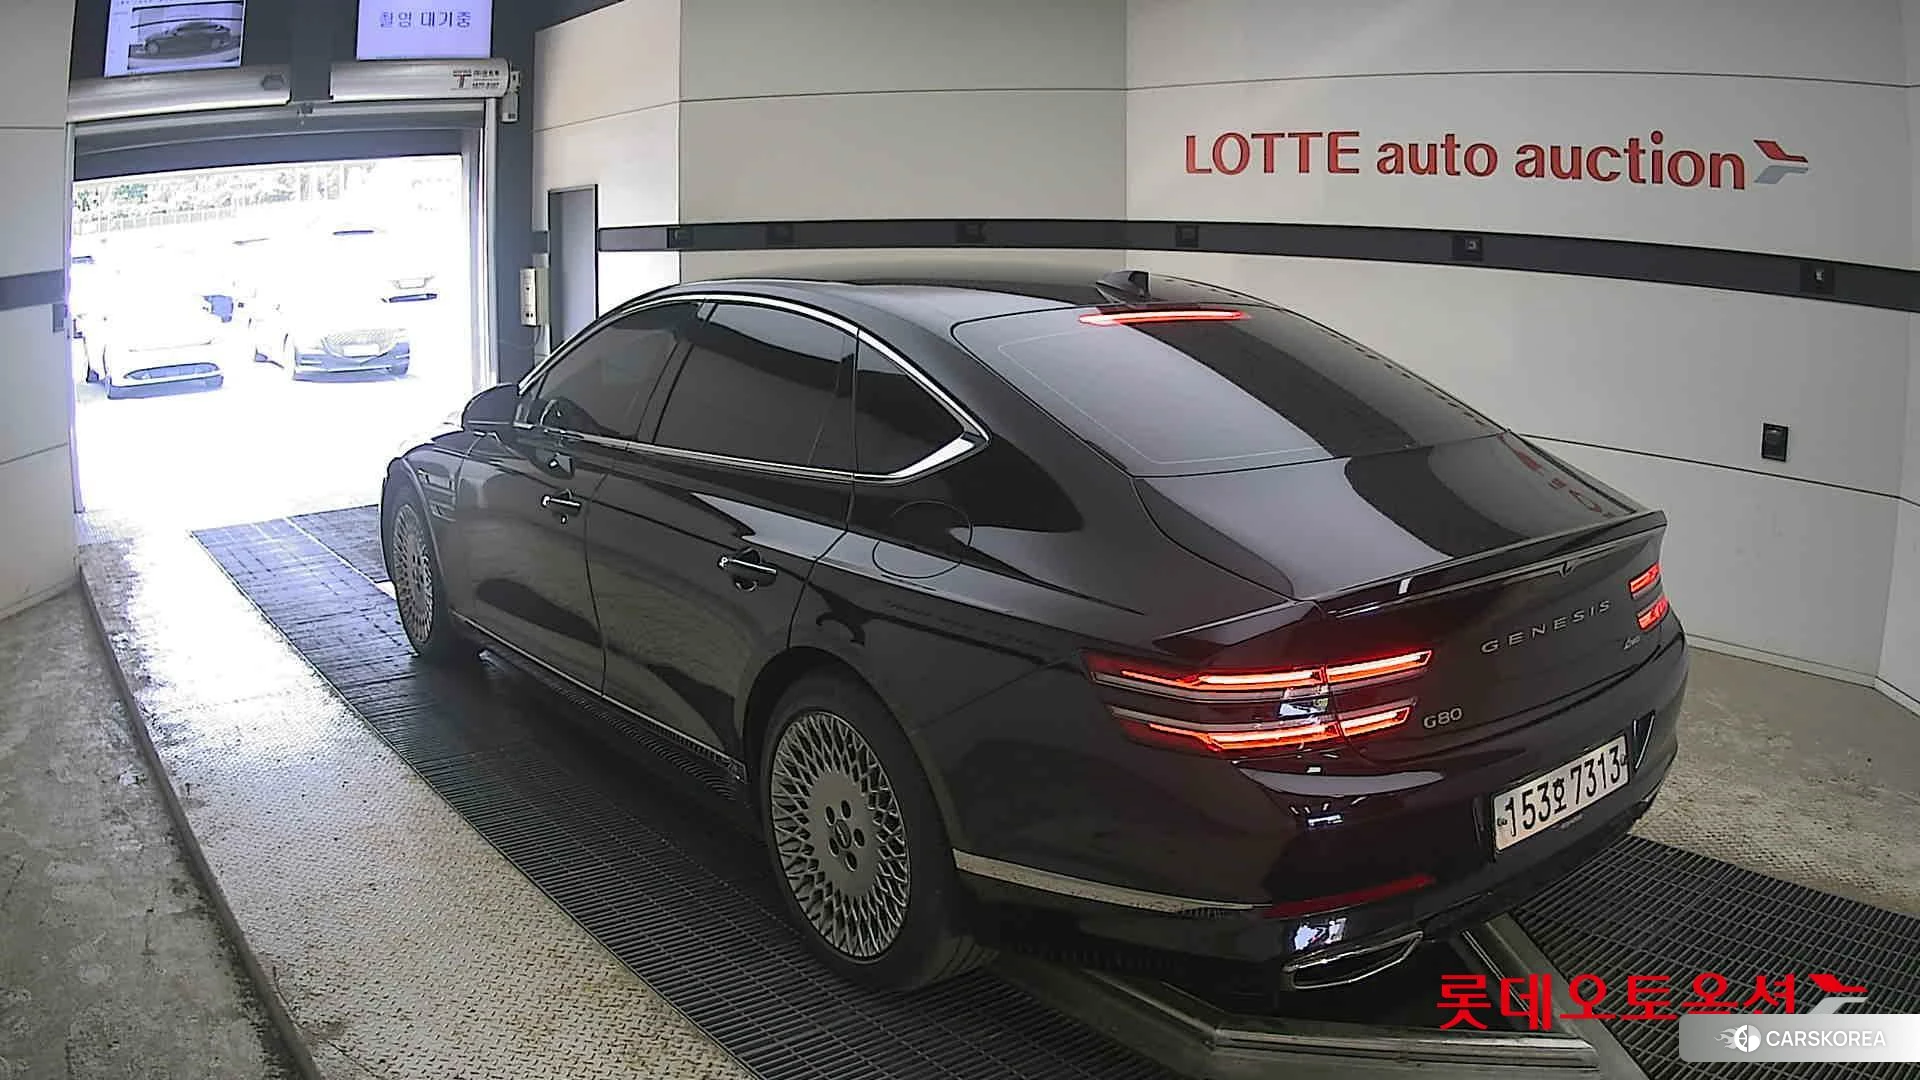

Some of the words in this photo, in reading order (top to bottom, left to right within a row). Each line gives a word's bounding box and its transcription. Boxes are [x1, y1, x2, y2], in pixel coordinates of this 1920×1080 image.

[420, 11, 471, 28] 대기중
[1186, 131, 1360, 175] LOTTE
[1376, 133, 1498, 177] auto
[1514, 130, 1745, 190] auction
[1480, 600, 1610, 654] GENESIS
[1423, 706, 1463, 729] G80
[1570, 745, 1621, 805] 7313
